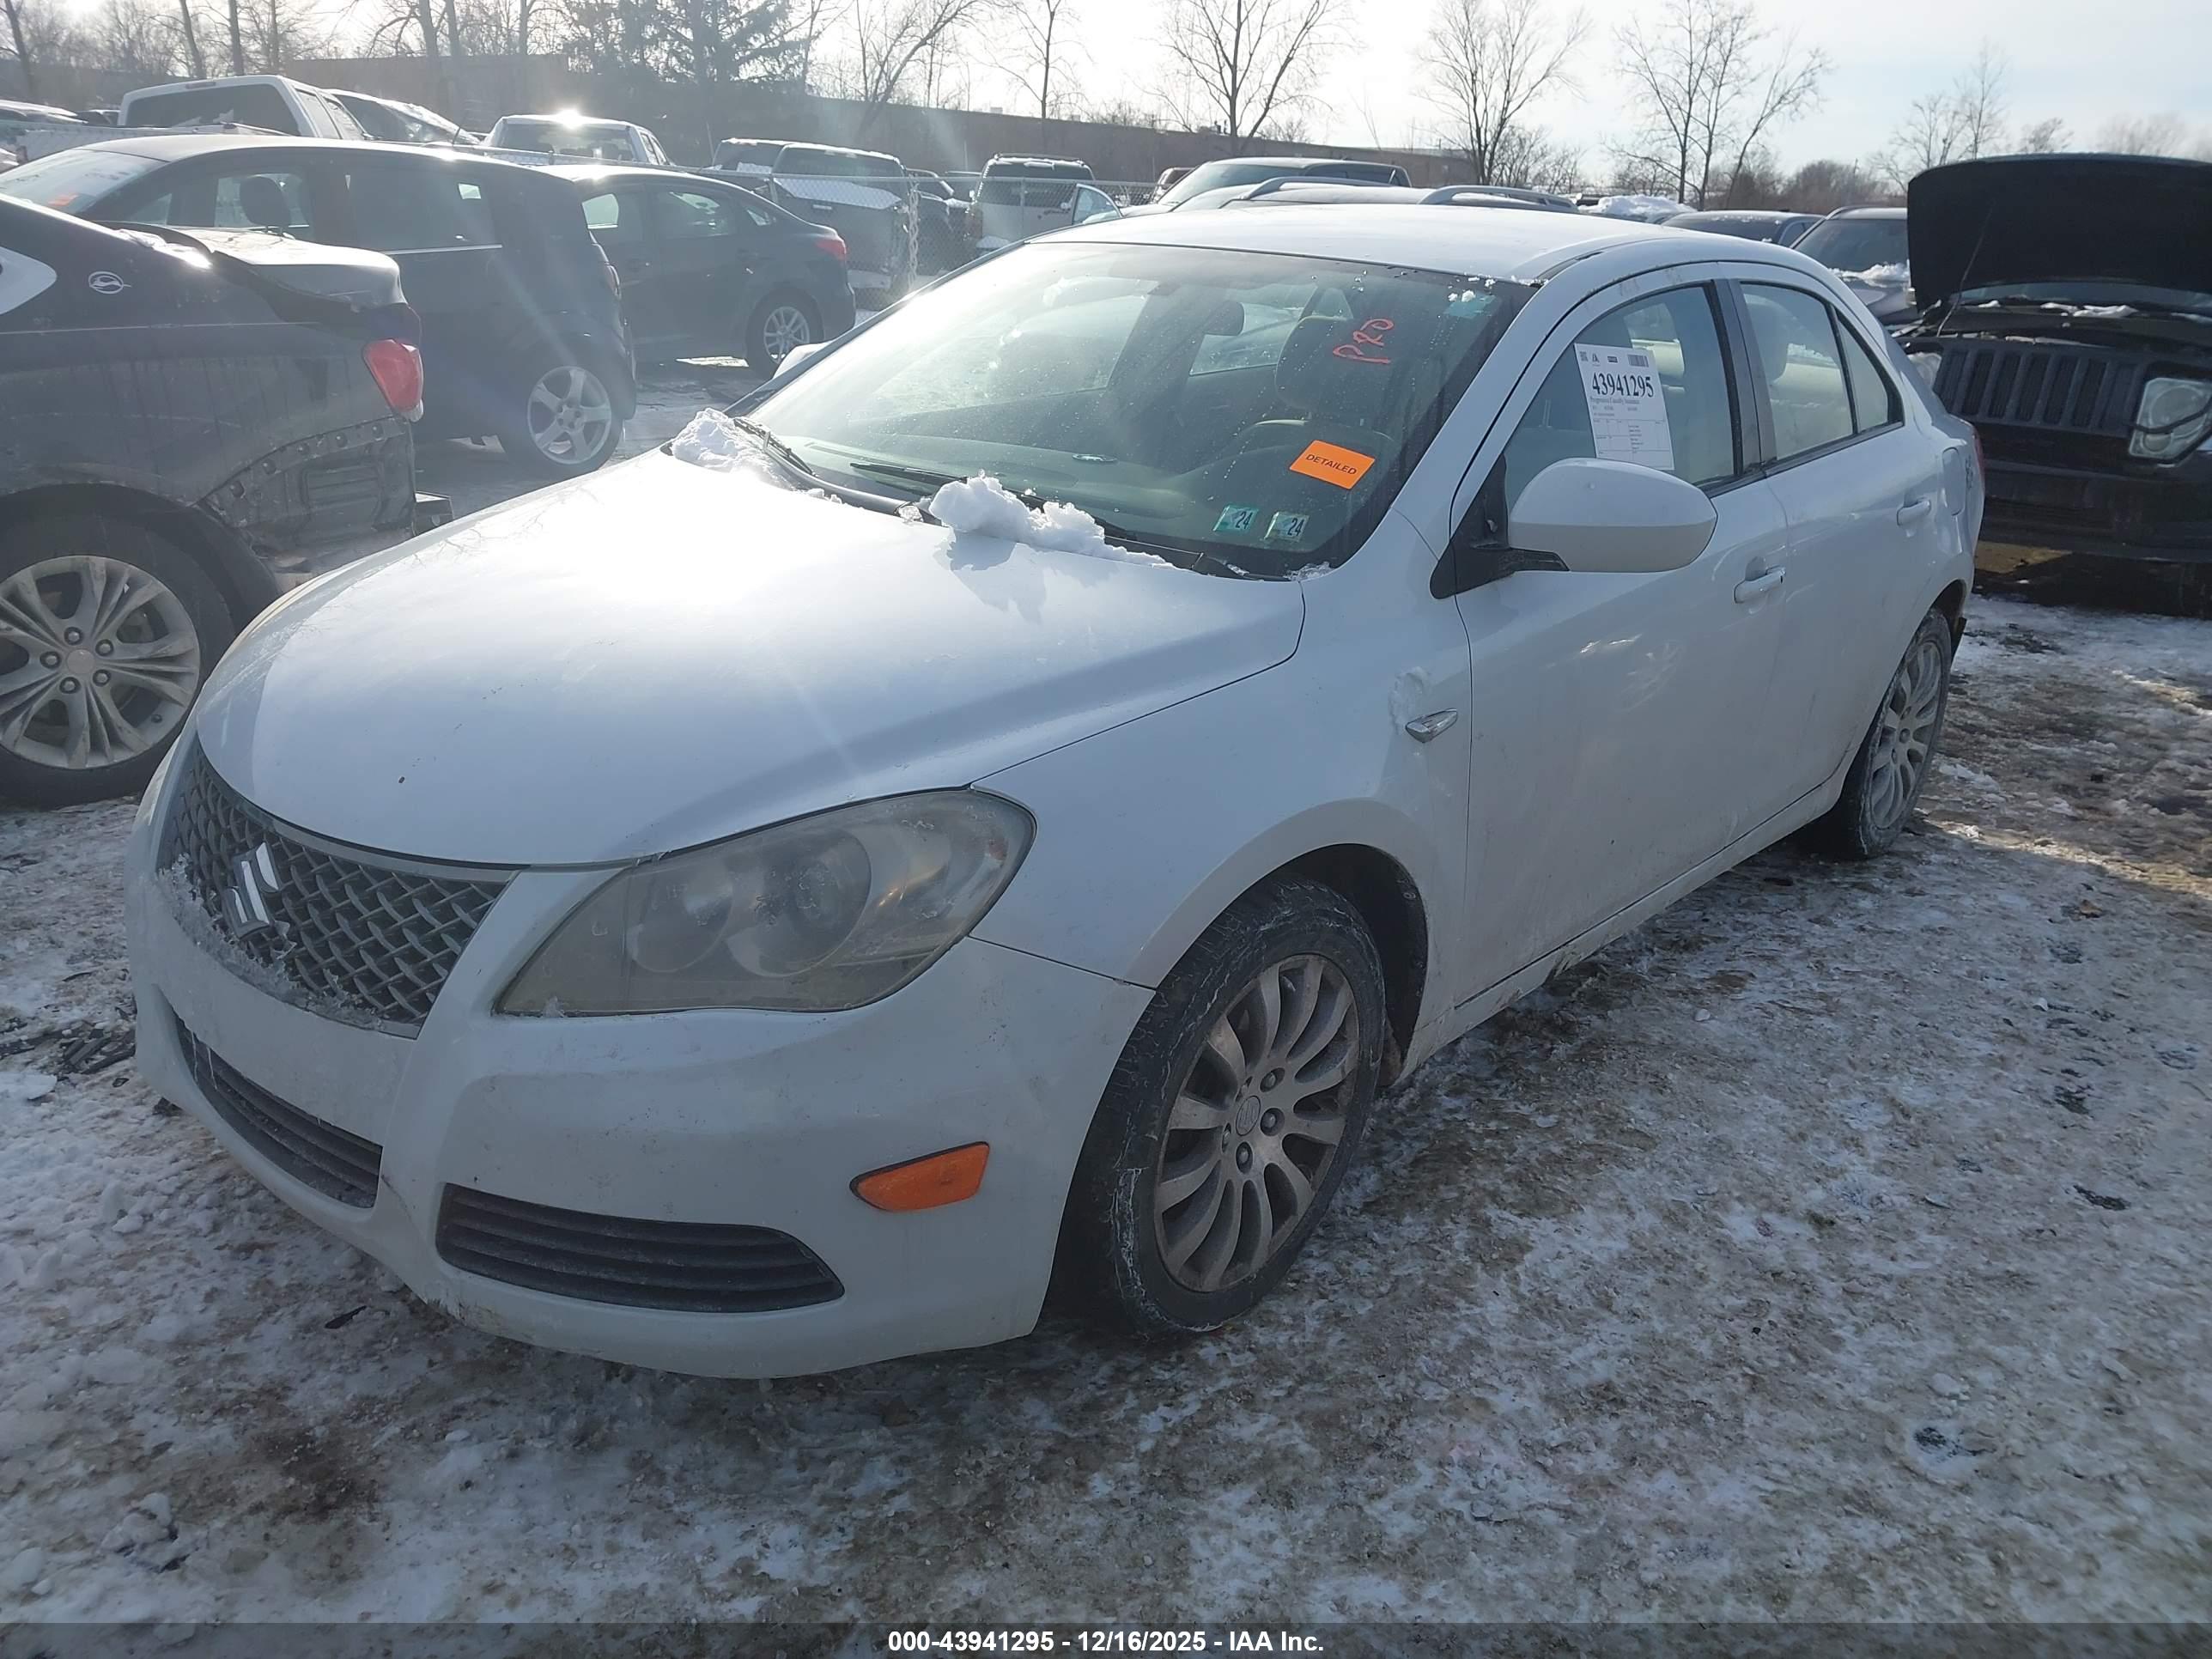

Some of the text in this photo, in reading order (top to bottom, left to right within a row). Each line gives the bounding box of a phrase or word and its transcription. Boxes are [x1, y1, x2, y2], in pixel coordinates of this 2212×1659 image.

[1592, 372, 1654, 398] 43941295
[1305, 453, 1358, 475] DETAILED
[1235, 511, 1254, 530] 24
[1288, 518, 1305, 537] 24
